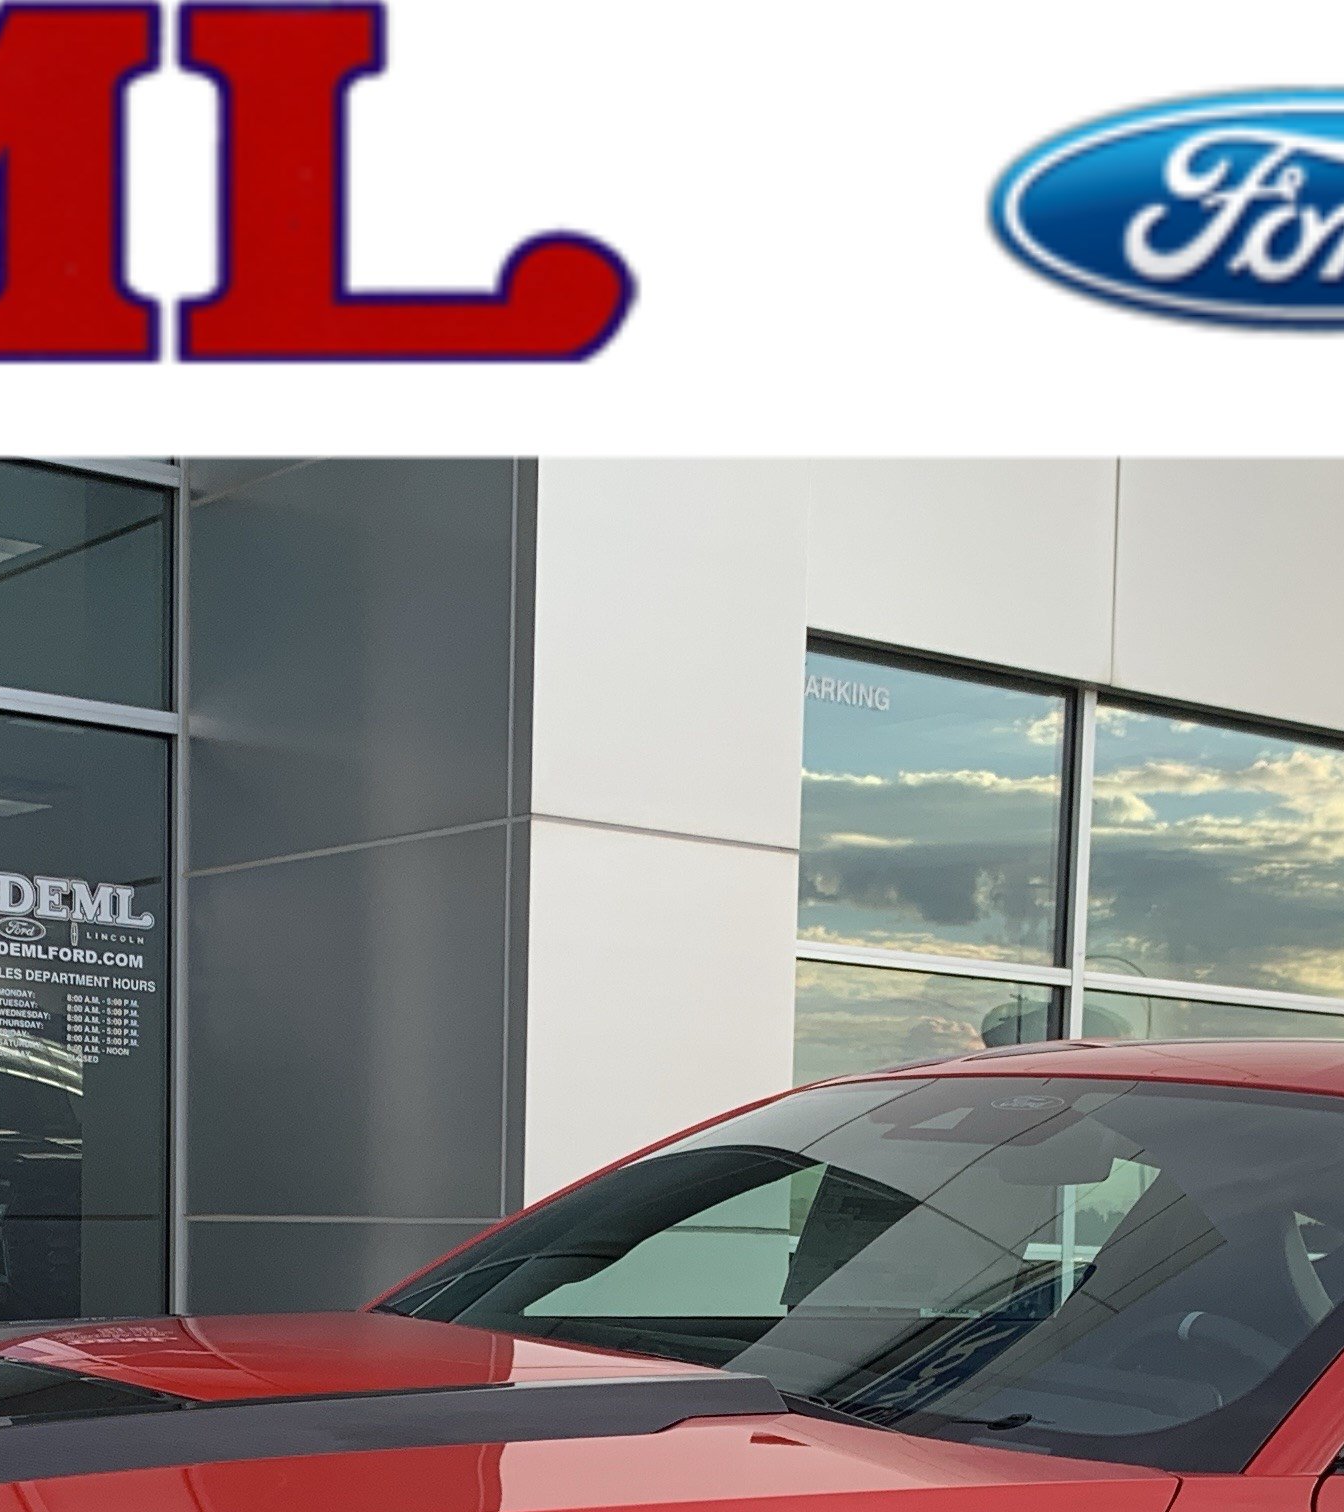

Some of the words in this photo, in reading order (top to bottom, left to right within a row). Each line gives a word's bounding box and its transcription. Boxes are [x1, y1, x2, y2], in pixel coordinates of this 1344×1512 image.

[804, 674, 890, 711] ARKING
[6, 921, 35, 937] Ford
[86, 932, 144, 944] LINCOLN
[25, 970, 110, 988] DEPARTMENT
[112, 976, 156, 993] HOURS
[106, 1046, 130, 1056] NOON
